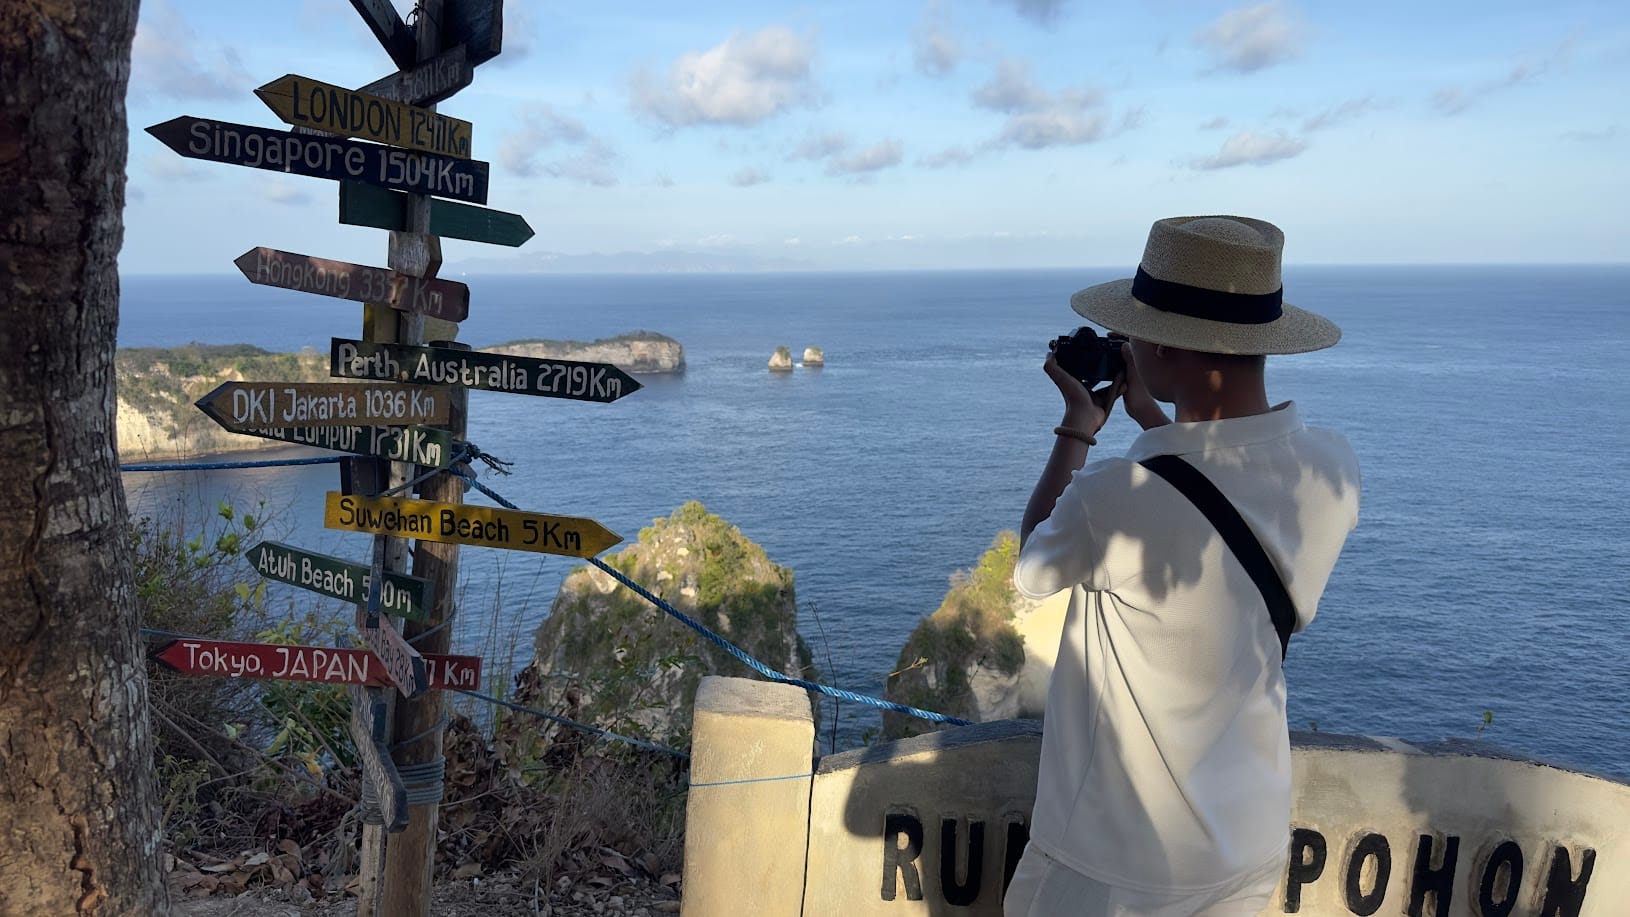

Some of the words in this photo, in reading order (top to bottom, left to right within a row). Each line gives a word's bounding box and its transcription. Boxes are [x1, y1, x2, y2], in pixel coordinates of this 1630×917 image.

[293, 81, 401, 142] LONDON
[188, 121, 365, 176] Singapore
[412, 279, 443, 314] Km
[414, 354, 528, 392] Australia
[233, 387, 274, 424] DKI
[282, 388, 356, 423] Jakarta
[365, 389, 407, 419] 1036
[410, 389, 435, 418] Km
[293, 425, 362, 450] Lumpur
[340, 498, 433, 534] Suwehan
[440, 509, 508, 543] Beach
[258, 546, 297, 582] Atuh
[301, 557, 354, 598] Beach
[361, 575, 412, 613] 50m
[183, 643, 264, 677] Tokyo,
[272, 648, 369, 683] JAPAN
[444, 659, 475, 687] Km
[1284, 828, 1597, 917] POHON
